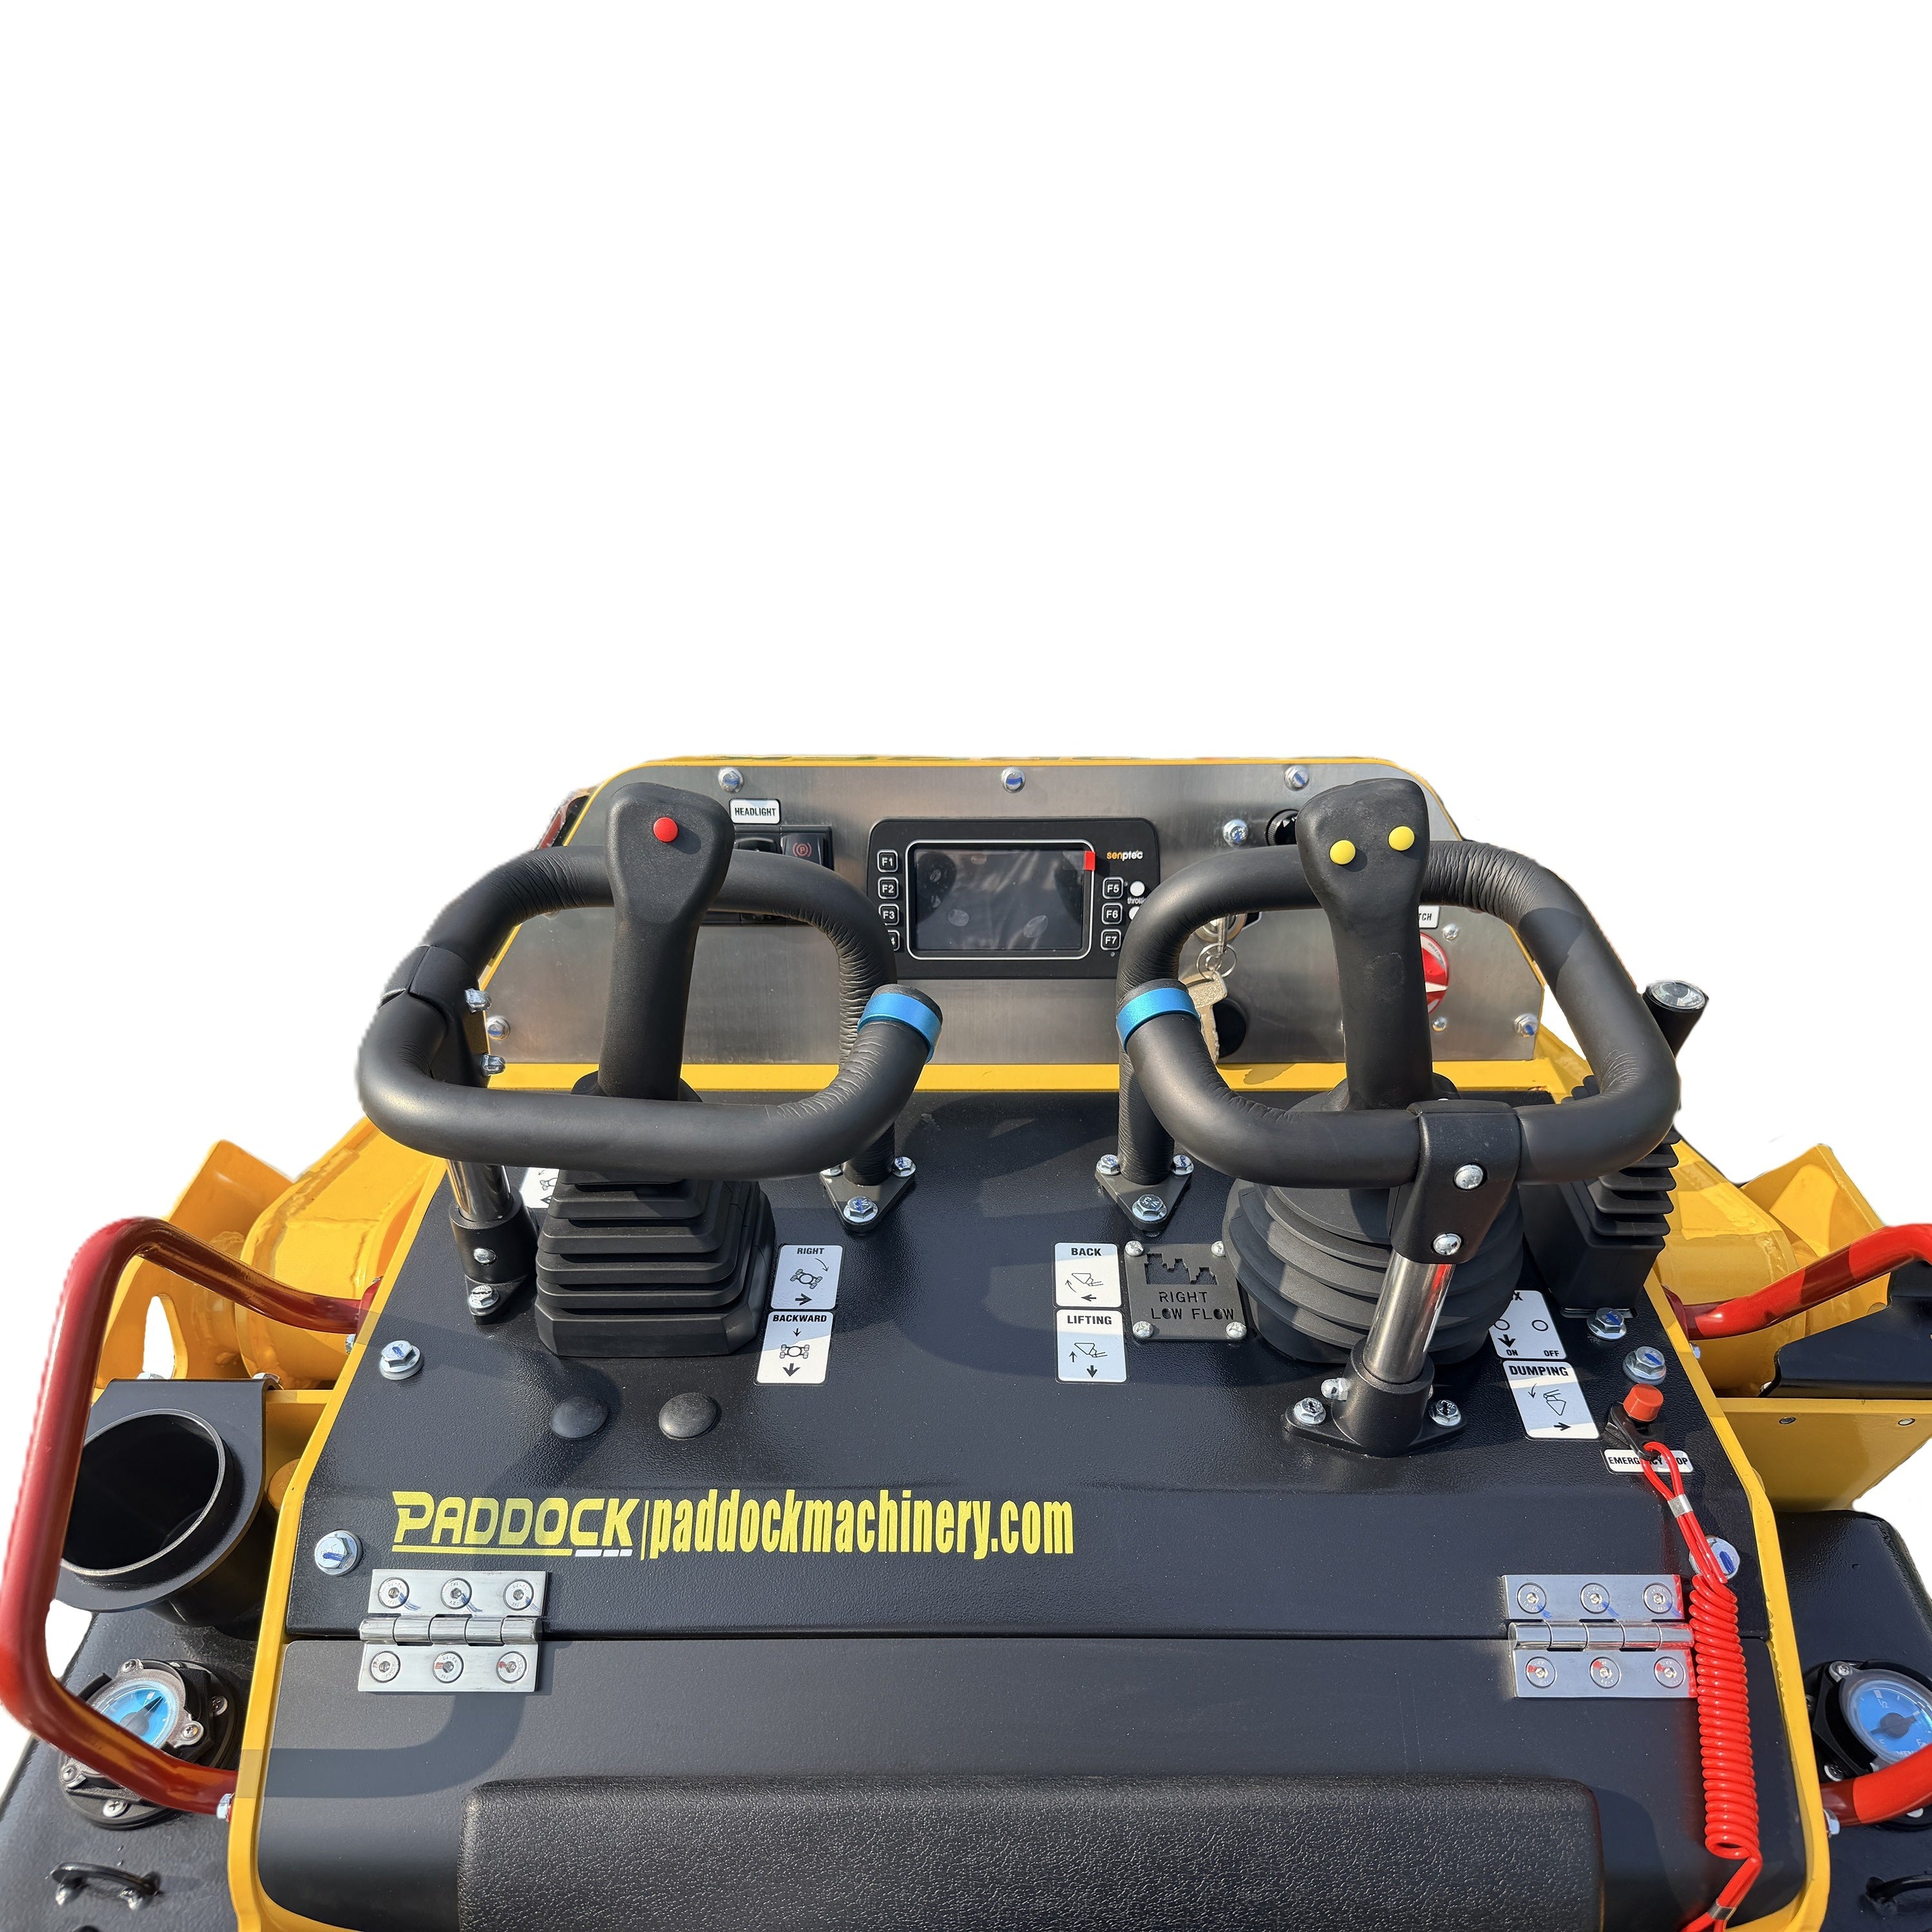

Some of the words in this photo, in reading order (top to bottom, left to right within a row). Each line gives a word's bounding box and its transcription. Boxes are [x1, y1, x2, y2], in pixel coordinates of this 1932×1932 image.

[735, 808, 776, 816] HEADLIGHT
[882, 858, 894, 866] F1
[1071, 1248, 1102, 1256] BACK
[1159, 1291, 1208, 1303] RIGHT
[1151, 1308, 1182, 1320] LOW
[1192, 1308, 1235, 1320] FLOW
[1067, 1316, 1112, 1325] LIFTING
[1508, 1365, 1569, 1376] DUMPING
[392, 1491, 640, 1547] PADDOCK
[650, 1489, 1074, 1560] paddockmachinery.com
